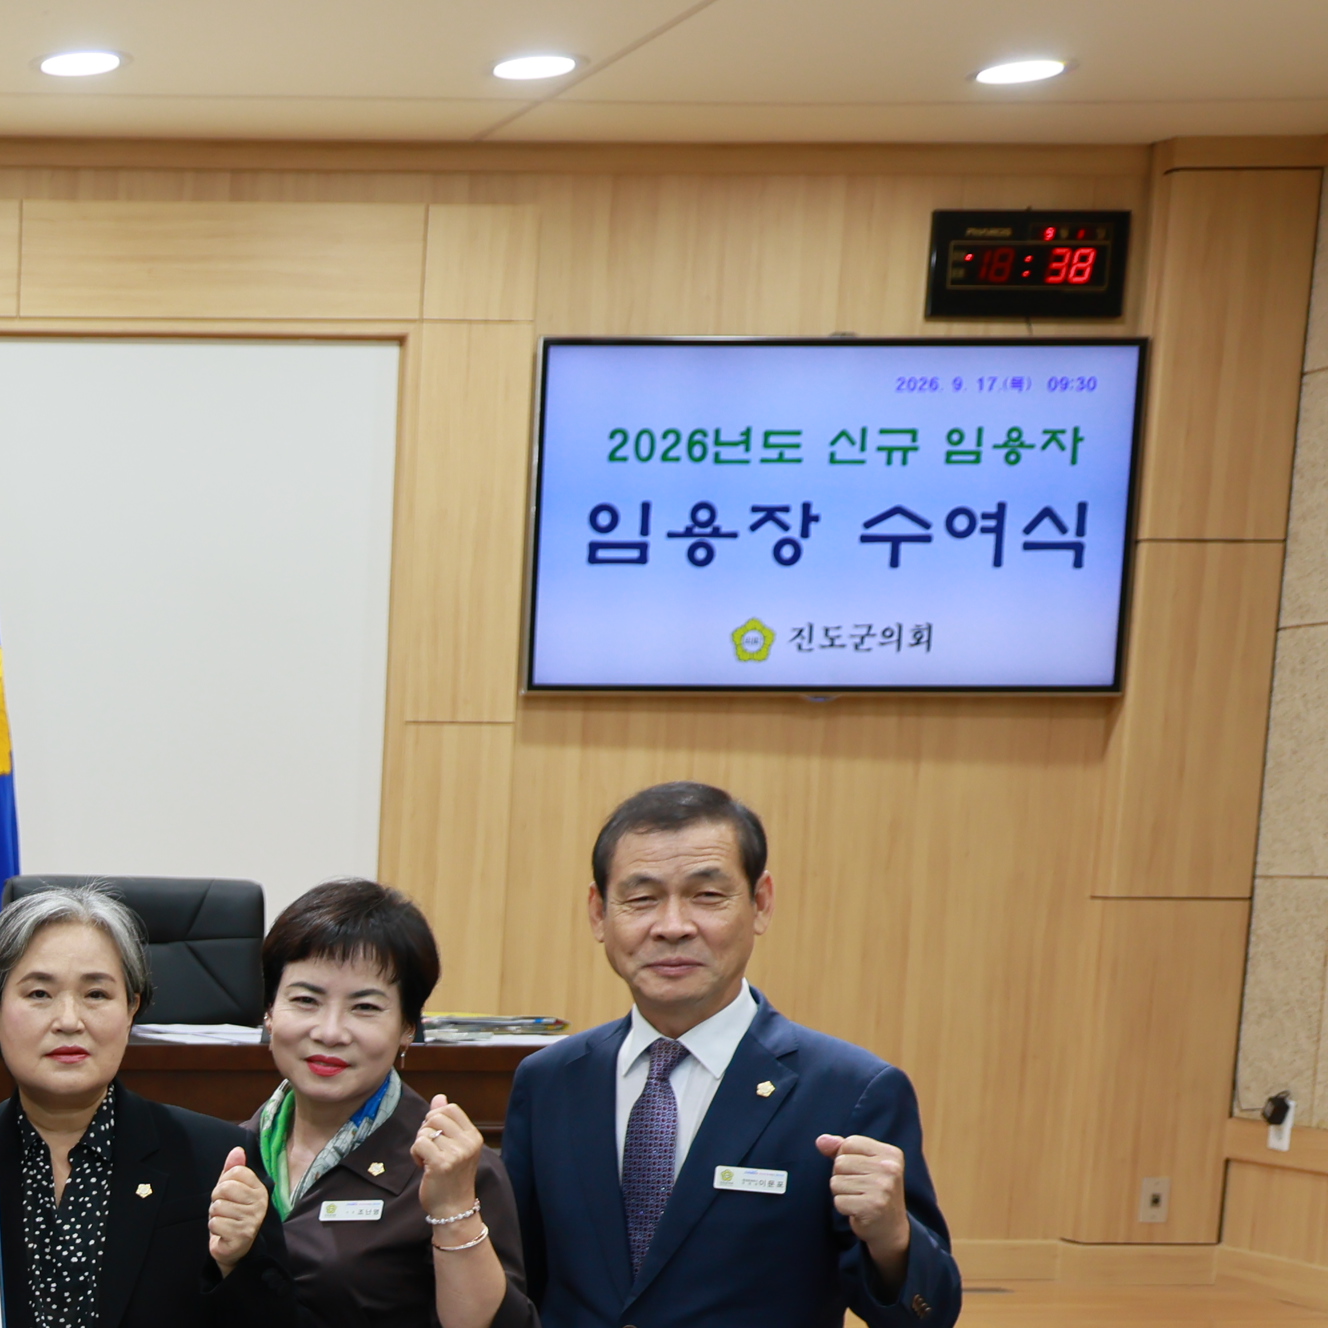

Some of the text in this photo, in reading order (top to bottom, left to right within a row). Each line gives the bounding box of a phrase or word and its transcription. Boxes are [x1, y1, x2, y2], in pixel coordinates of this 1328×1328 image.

[896, 376, 944, 392] 2026.
[978, 377, 1031, 392] 17.(목)
[608, 426, 1084, 466] 2026년도 신규 임용자
[587, 501, 1088, 569] 임용장 수여식
[790, 623, 932, 652] 진도군의회
